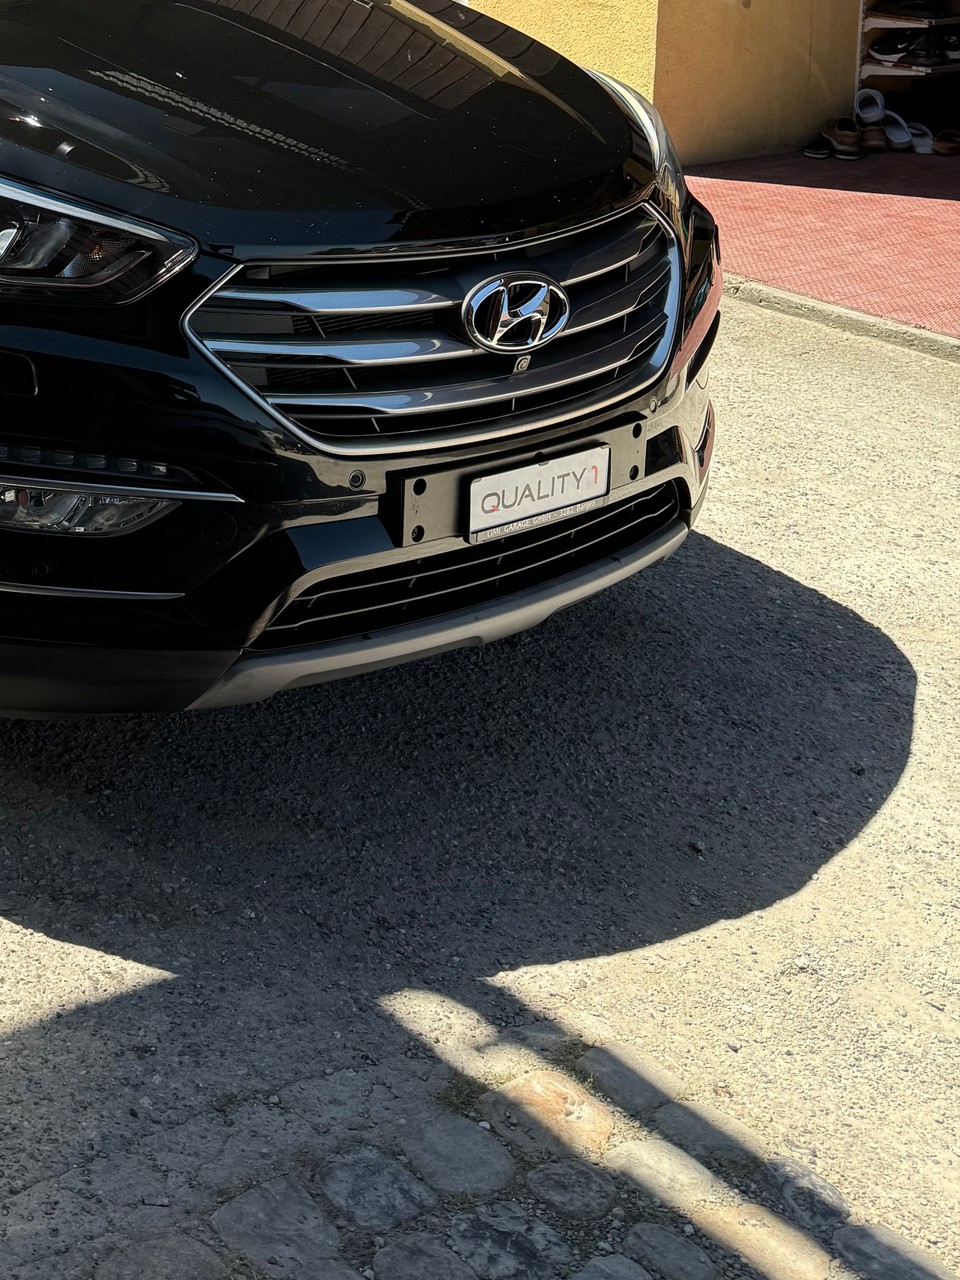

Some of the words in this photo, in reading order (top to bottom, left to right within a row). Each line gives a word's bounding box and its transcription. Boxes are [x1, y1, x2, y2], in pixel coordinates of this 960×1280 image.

[481, 467, 587, 514] QUALITY
[591, 465, 599, 485] 1
[504, 519, 531, 533] GARAGE
